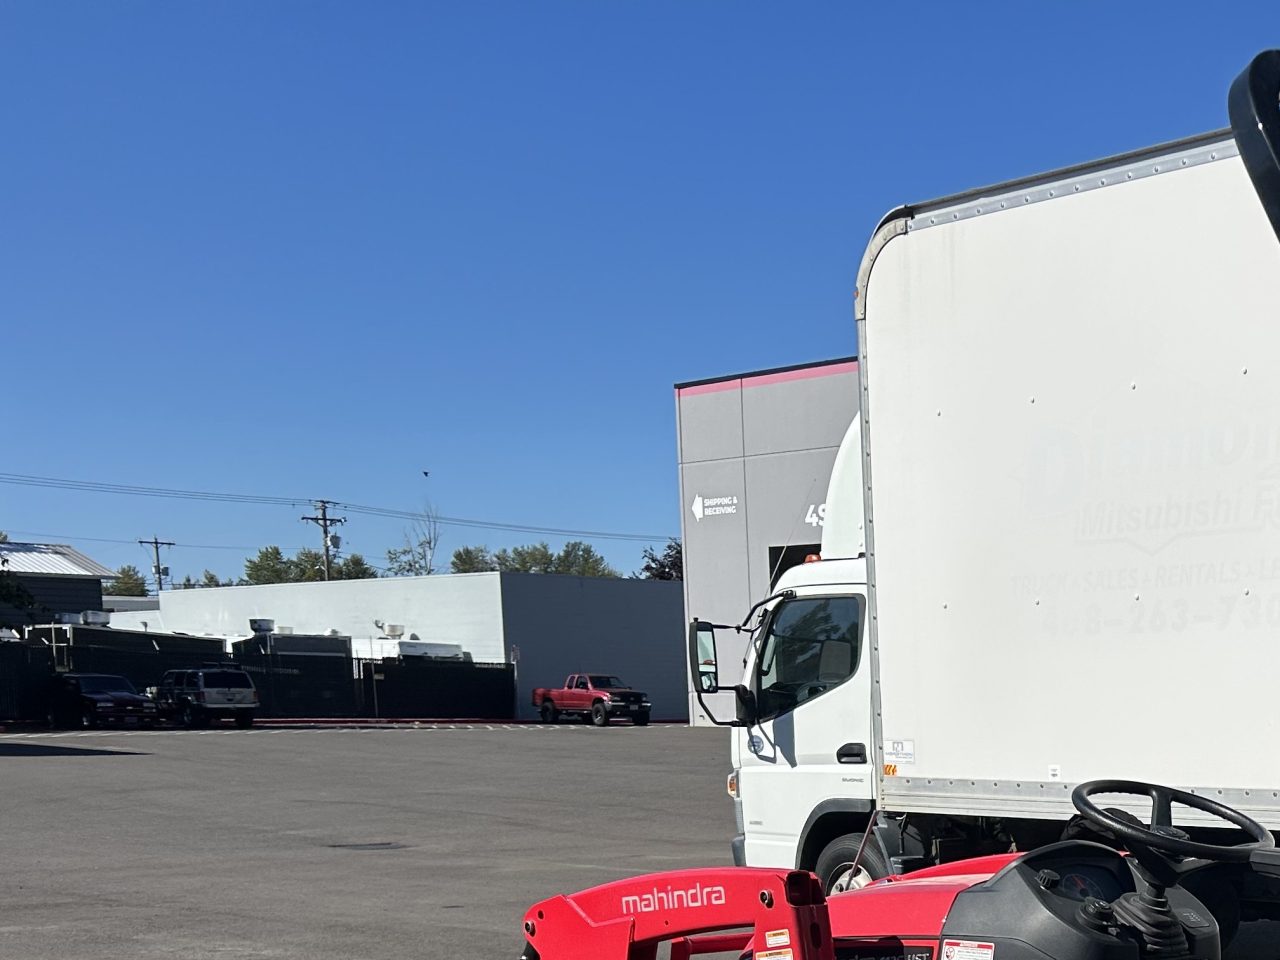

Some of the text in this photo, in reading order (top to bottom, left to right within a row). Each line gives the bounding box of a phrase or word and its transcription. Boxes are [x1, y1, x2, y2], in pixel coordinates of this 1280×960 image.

[703, 496, 733, 507] SHIPPING
[704, 506, 737, 516] RECEIVING
[1079, 486, 1243, 536] Mitsubishi
[1082, 567, 1138, 592] SALES
[1154, 560, 1239, 588] RENTALS
[621, 882, 726, 914] mahindra
